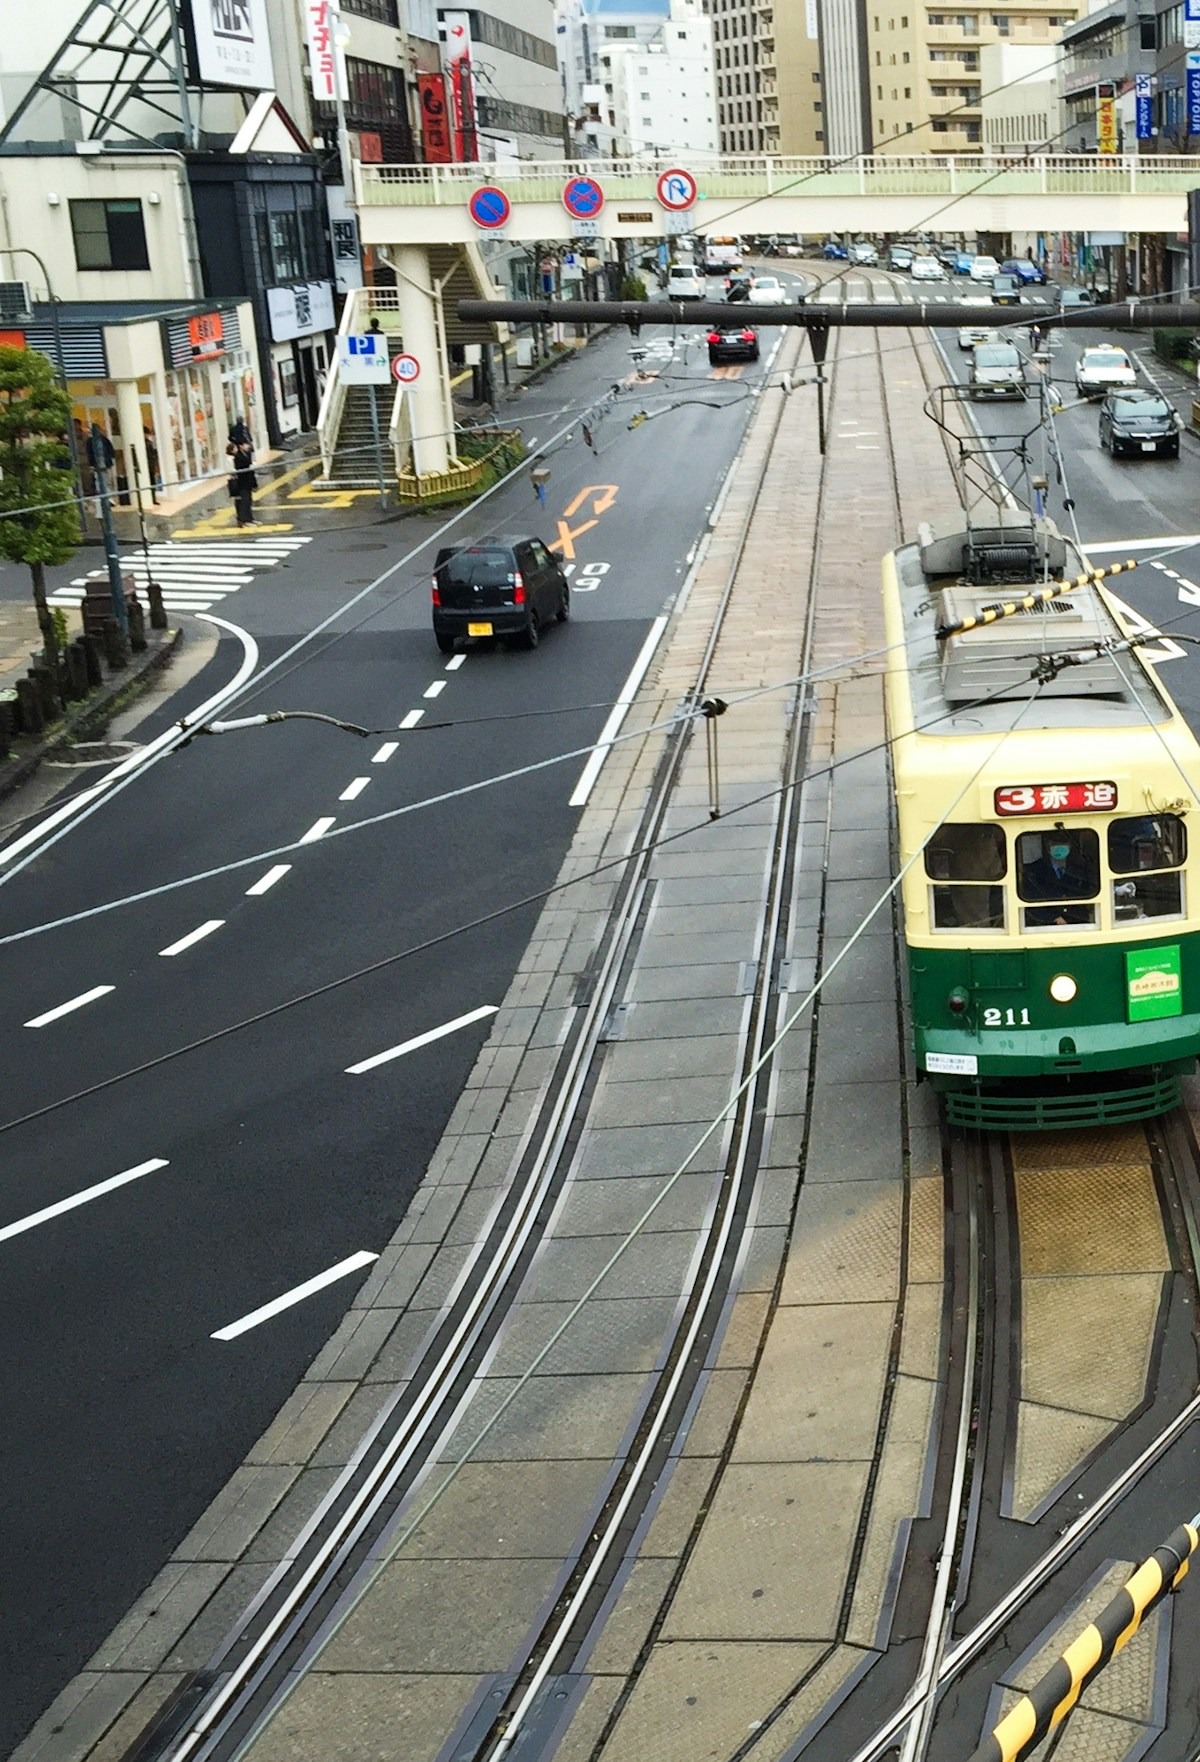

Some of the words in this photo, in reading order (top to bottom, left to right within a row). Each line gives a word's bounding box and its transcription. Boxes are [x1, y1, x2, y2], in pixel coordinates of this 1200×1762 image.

[332, 221, 355, 258] 和民
[356, 337, 369, 355] P
[399, 362, 414, 375] 40
[999, 786, 1036, 811] 3
[1040, 783, 1116, 810] 赤迫
[982, 1006, 1032, 1026] 211
